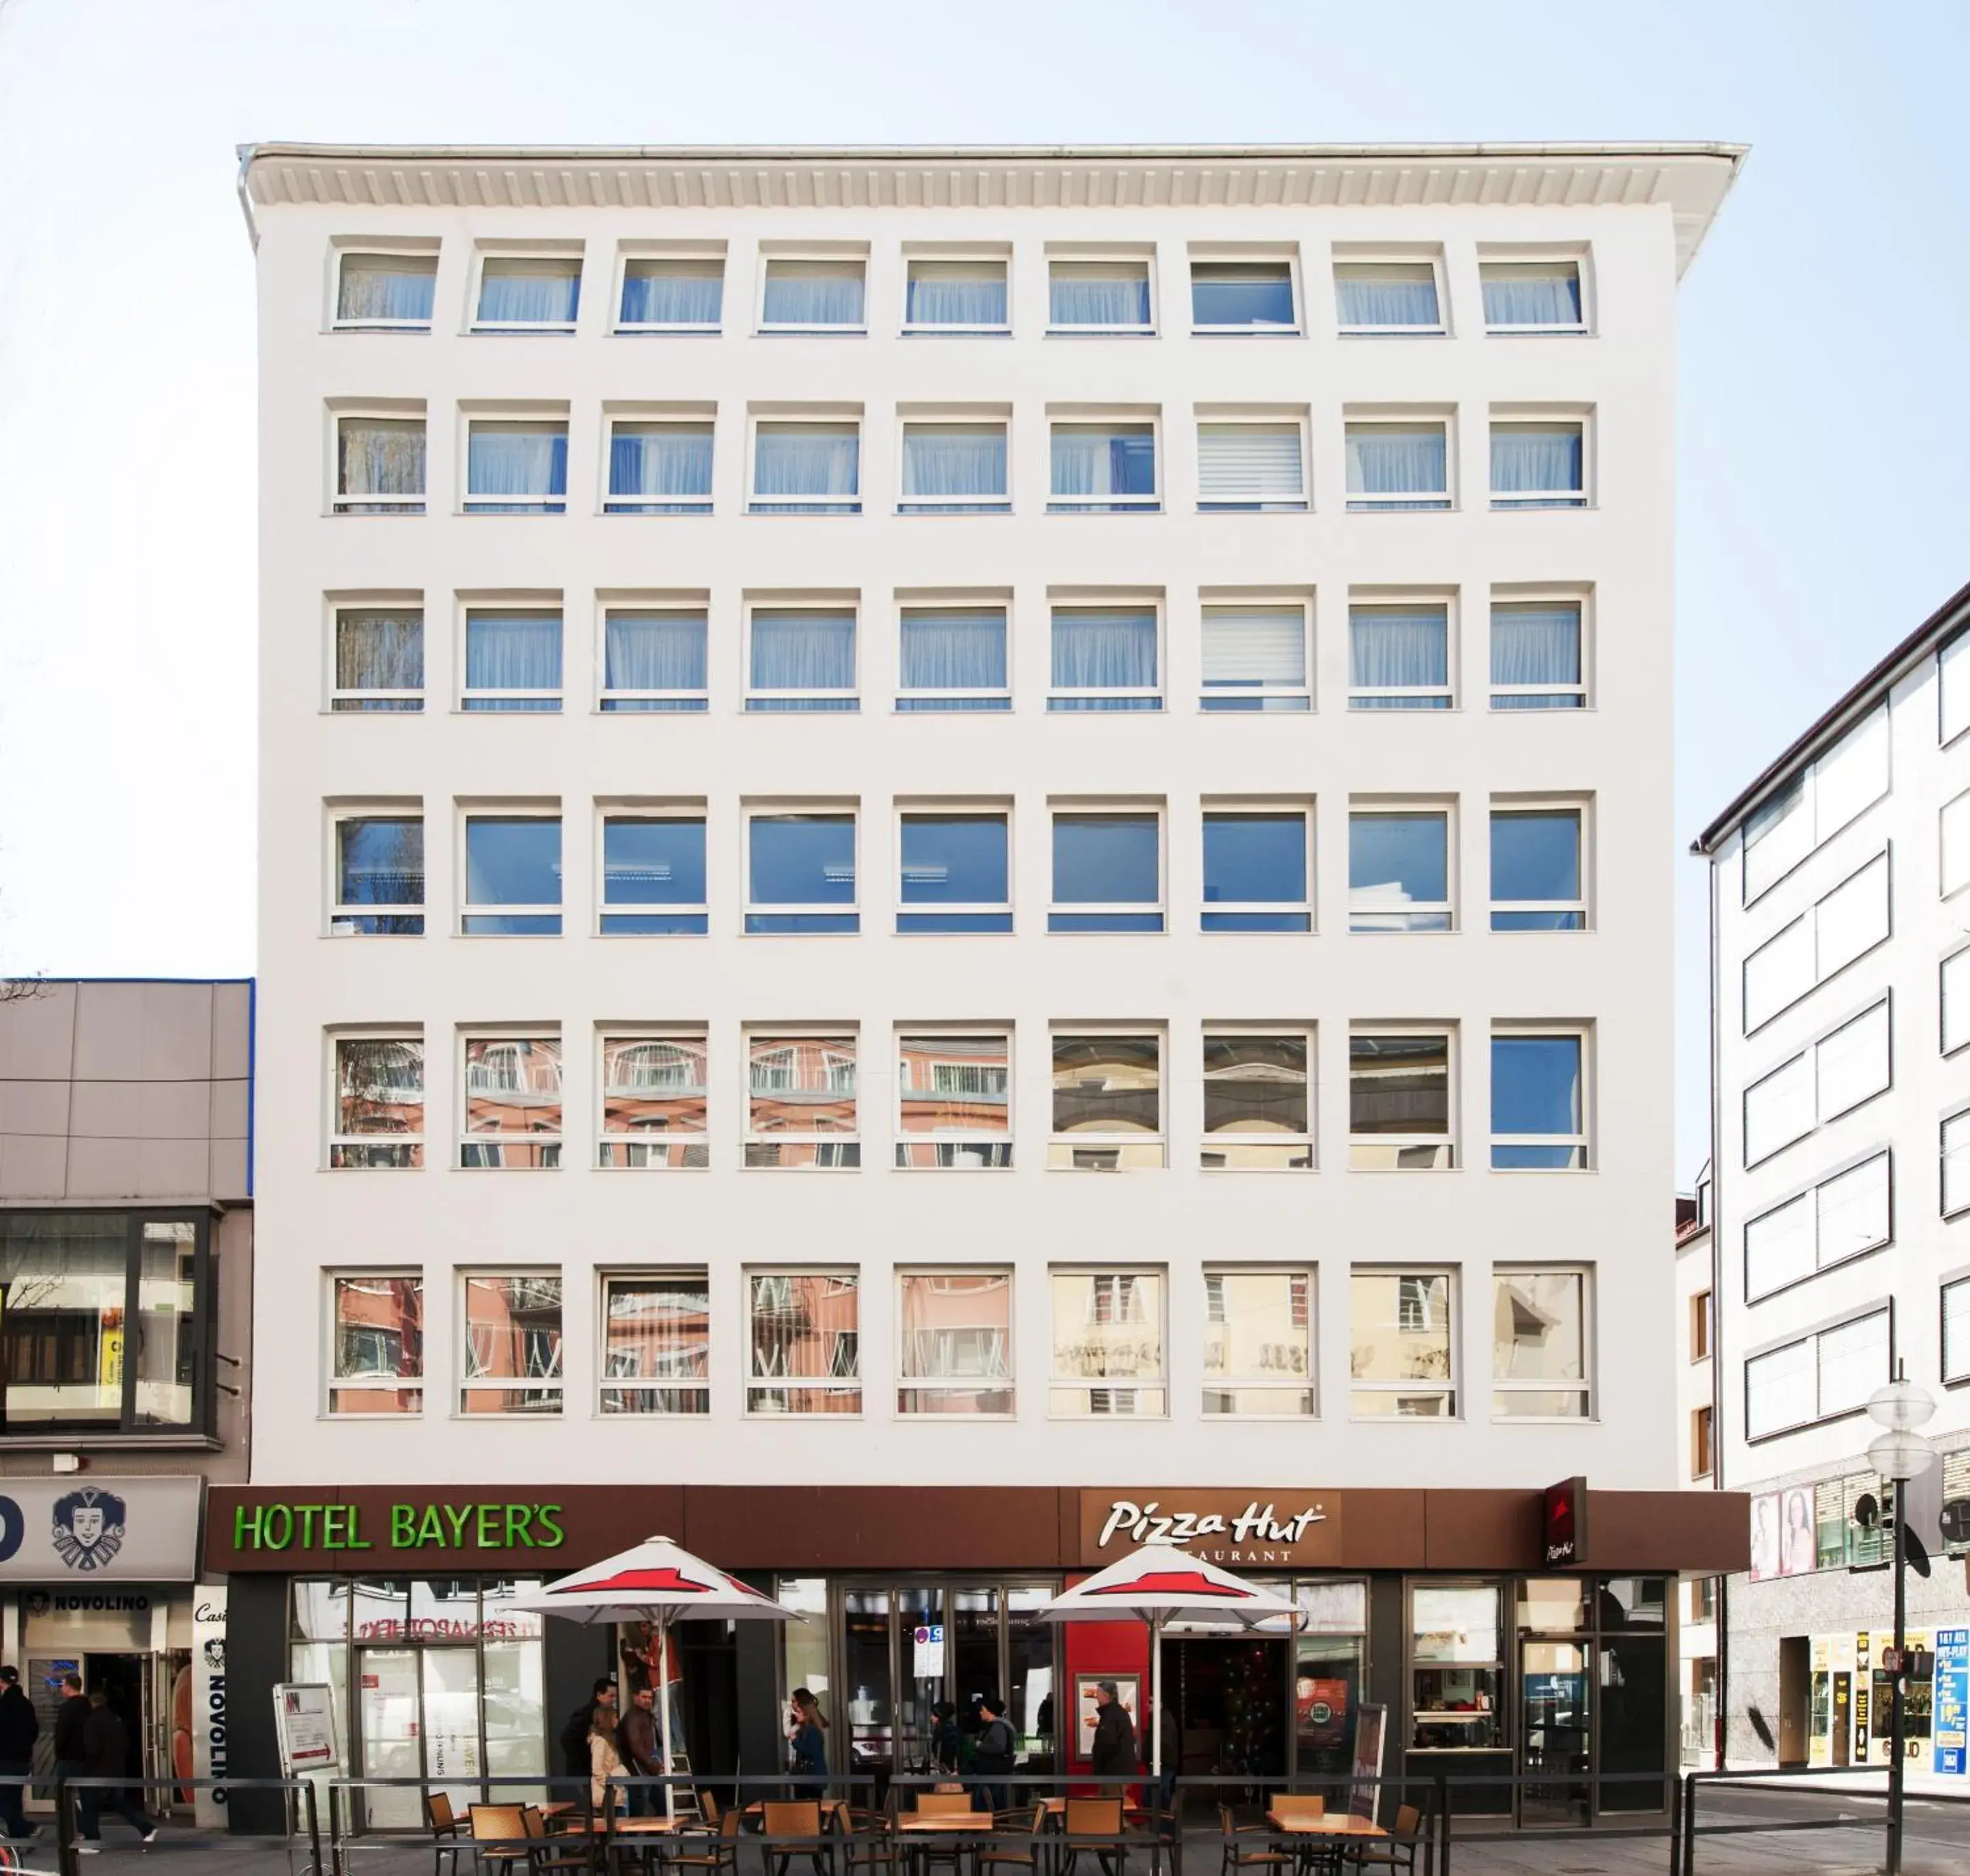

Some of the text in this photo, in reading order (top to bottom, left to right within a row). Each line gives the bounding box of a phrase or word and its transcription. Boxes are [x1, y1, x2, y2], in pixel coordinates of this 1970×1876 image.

[234, 1504, 565, 1550] HOTEL BAYER'S
[1098, 1501, 1327, 1548] Pizza Hut
[1187, 1550, 1291, 1561] AURANT
[1547, 1545, 1562, 1561] Pizza
[55, 1596, 149, 1610] NOVOLINO
[210, 1675, 227, 1804] NOVOLINO
